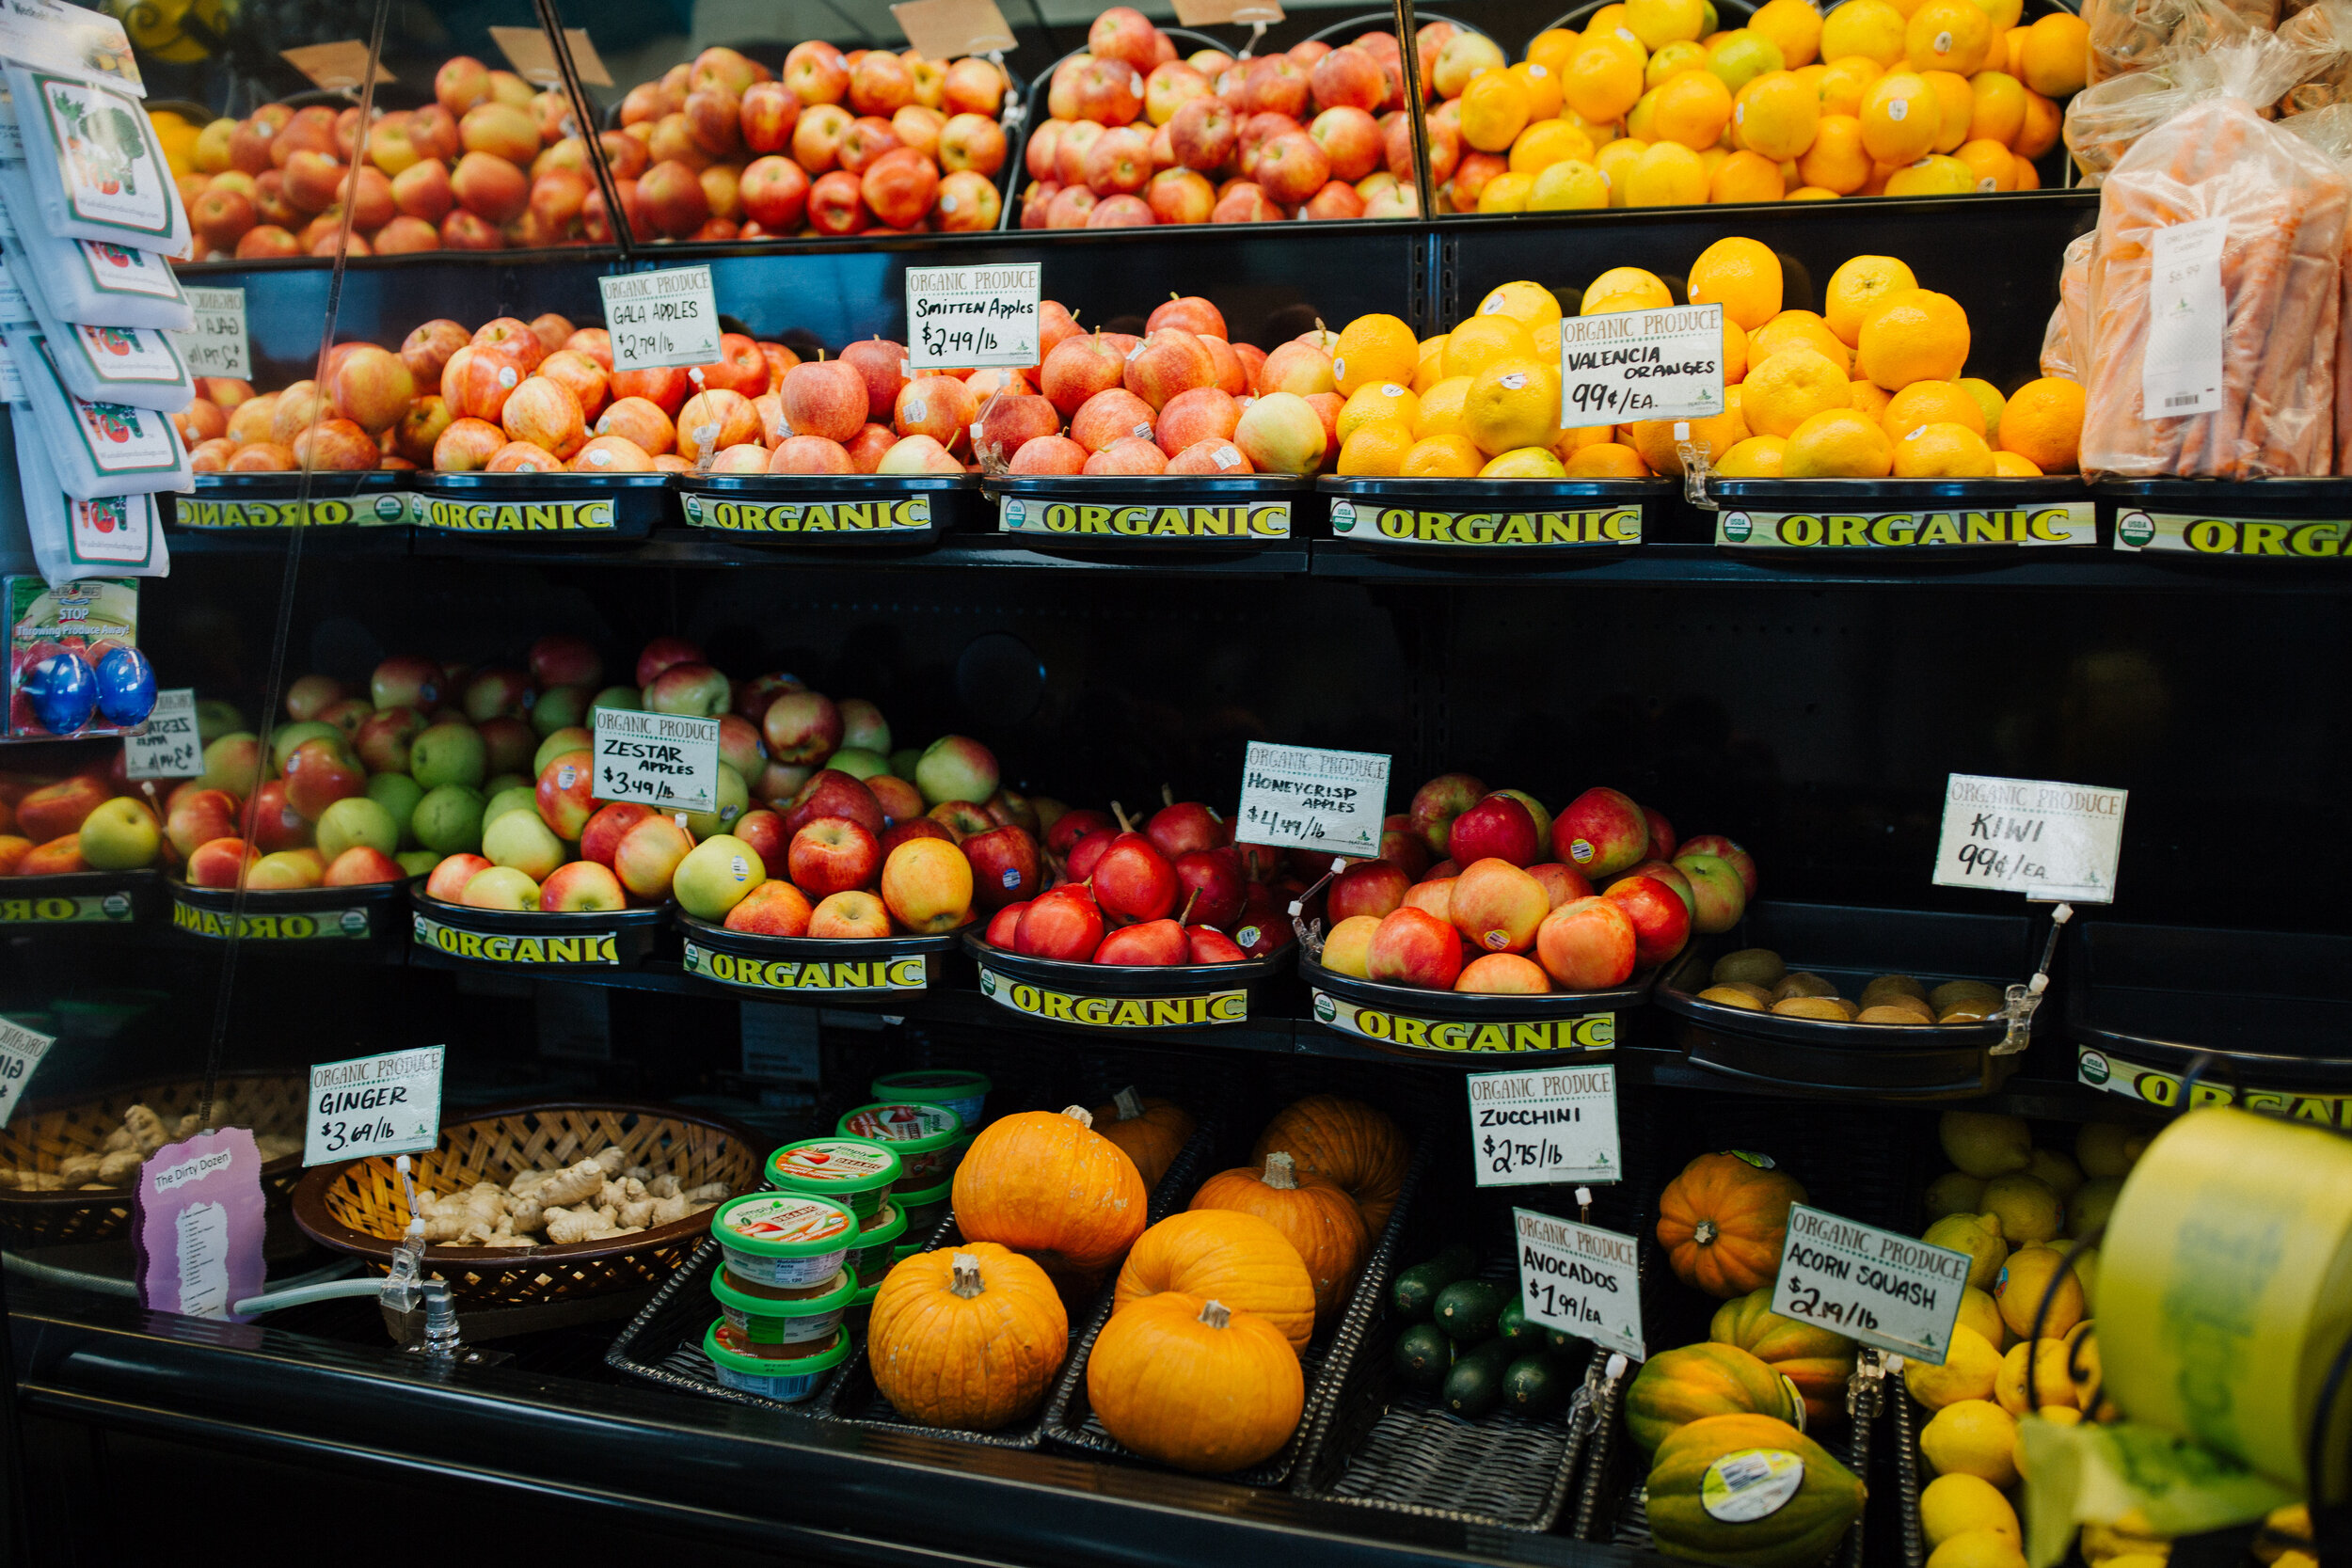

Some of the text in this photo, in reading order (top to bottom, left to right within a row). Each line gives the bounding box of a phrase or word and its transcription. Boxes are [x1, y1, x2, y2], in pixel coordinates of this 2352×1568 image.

[604, 272, 709, 300] ORGANIC PRODUCE
[910, 270, 1037, 292] ORGANIC PRODUCE
[613, 301, 698, 325] GALA APPLES
[988, 297, 1034, 320] Apples
[922, 321, 998, 356] $2.49/lb
[1564, 309, 1719, 343] ORGANIC PRODUCE
[618, 331, 675, 360] $2.79/lb
[1568, 346, 1661, 372] VALENCIA
[1624, 360, 1715, 380] ORANGES
[430, 501, 612, 531] ORGANIC
[715, 499, 930, 532] ORGANIC
[1042, 503, 1288, 536] ORGANIC
[1376, 507, 1642, 544] ORGANIC
[1776, 508, 2072, 547] ORGANIC
[2183, 519, 2352, 557] ORG
[59, 608, 89, 620] STOP
[17, 625, 130, 638] Throwing Produce Away!
[596, 712, 717, 741] ORGANIC PRODUCE
[603, 739, 684, 763] ZESTAR
[639, 760, 694, 775] APPLES
[1248, 747, 1387, 780] ORGANIC PRODUCE
[603, 766, 675, 800] $3.49/lb
[1248, 771, 1358, 800] HONEYCRISP
[1951, 782, 2120, 816] ORGANIC PRODUCE
[1302, 798, 1356, 813] APPLES
[1971, 813, 2044, 842] KIWI
[710, 953, 926, 989] ORGANIC
[1010, 984, 1247, 1027] ORGANIC
[1355, 1007, 1614, 1052] ORGANIC
[313, 1052, 440, 1088] ORGANIC PRODUCE
[1471, 1072, 1612, 1101] ORGANIC PRODUCE
[319, 1086, 407, 1116] GINGER
[1479, 1107, 1581, 1127] ZUCCHINI
[321, 1116, 395, 1151] $3.69/lb
[155, 1152, 230, 1188] The Dirty Dozen
[1483, 1134, 1563, 1173] $2.75/lb
[1518, 1215, 1635, 1266] ORGANIC PRODUCE
[1792, 1212, 1966, 1281] ORGANIC PRODUCE
[1523, 1245, 1619, 1293] AVOCADOS
[1788, 1243, 1936, 1311] ACORN SQUASH
[1529, 1278, 1604, 1325] $1.99/EA
